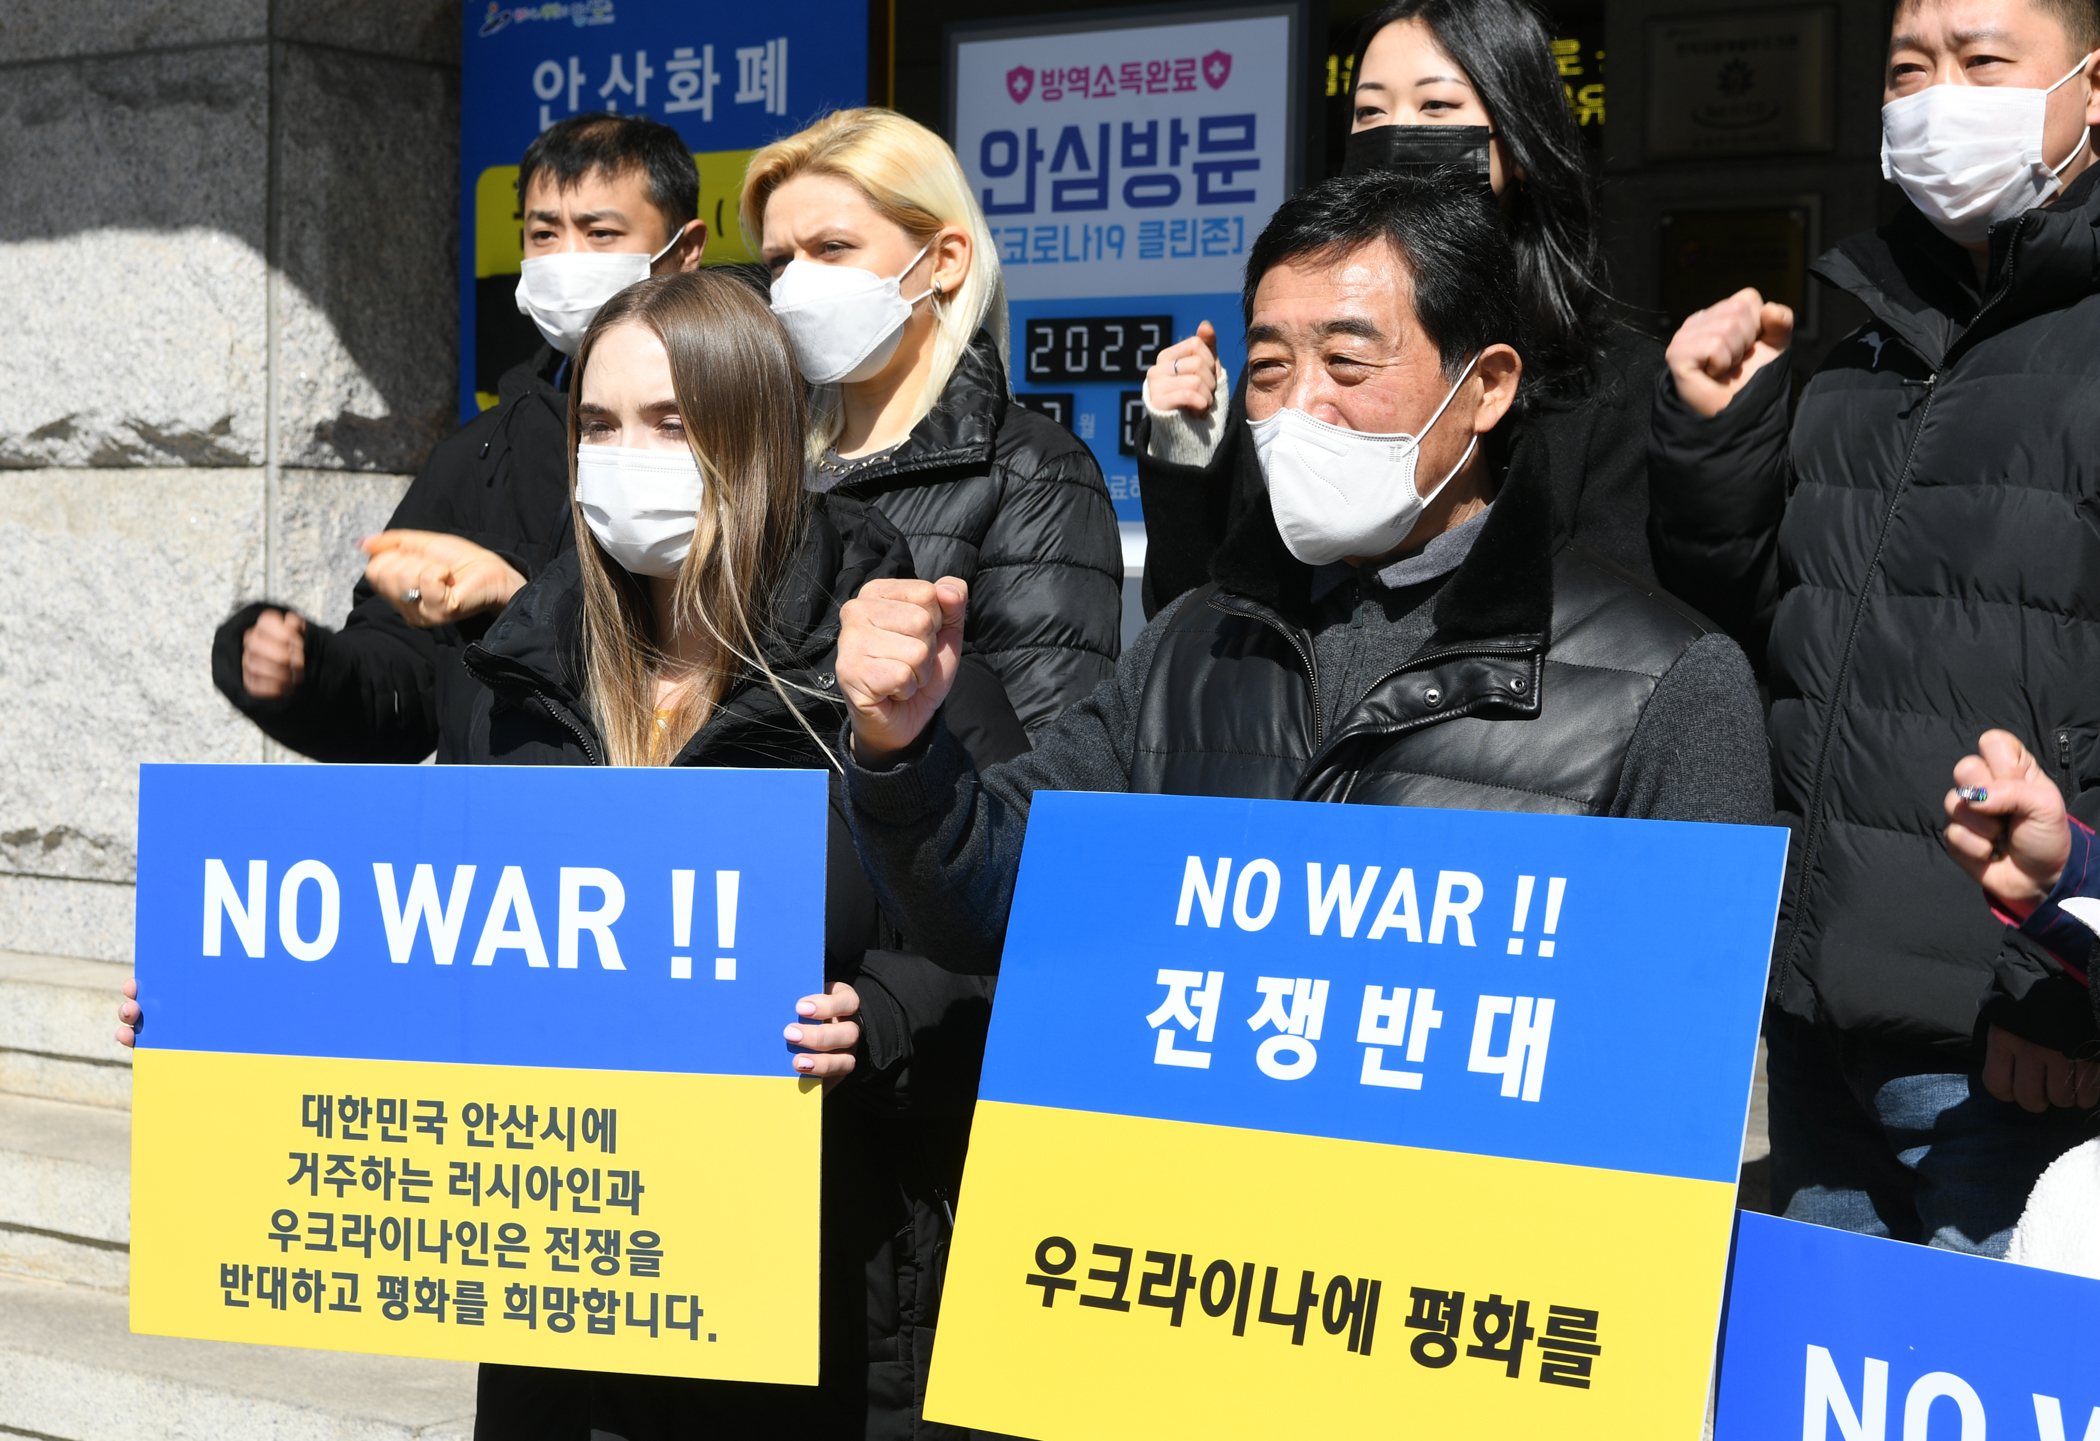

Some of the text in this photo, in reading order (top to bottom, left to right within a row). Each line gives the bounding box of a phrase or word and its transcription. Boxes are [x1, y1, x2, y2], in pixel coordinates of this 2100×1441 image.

[533, 37, 788, 131] 안산화폐
[1041, 57, 1197, 103] 방역소독완료
[979, 113, 1260, 216] 안심방문
[1138, 216, 1244, 260] 클린존]
[1030, 323, 1160, 373] 2022
[203, 859, 740, 980] NO WAR !!
[1176, 856, 1567, 957] NO WAR !!
[303, 1095, 617, 1153] 대한민국 안산시에
[287, 1153, 645, 1215] 거주하는 러시아인과
[269, 1209, 663, 1277] 우크라이나인은 전쟁을
[221, 1264, 717, 1343] 반대하고 평화를 희망합니다.
[1026, 1237, 1602, 1390] 우크라이나에 평화를
[1803, 1344, 1986, 1441] NO
